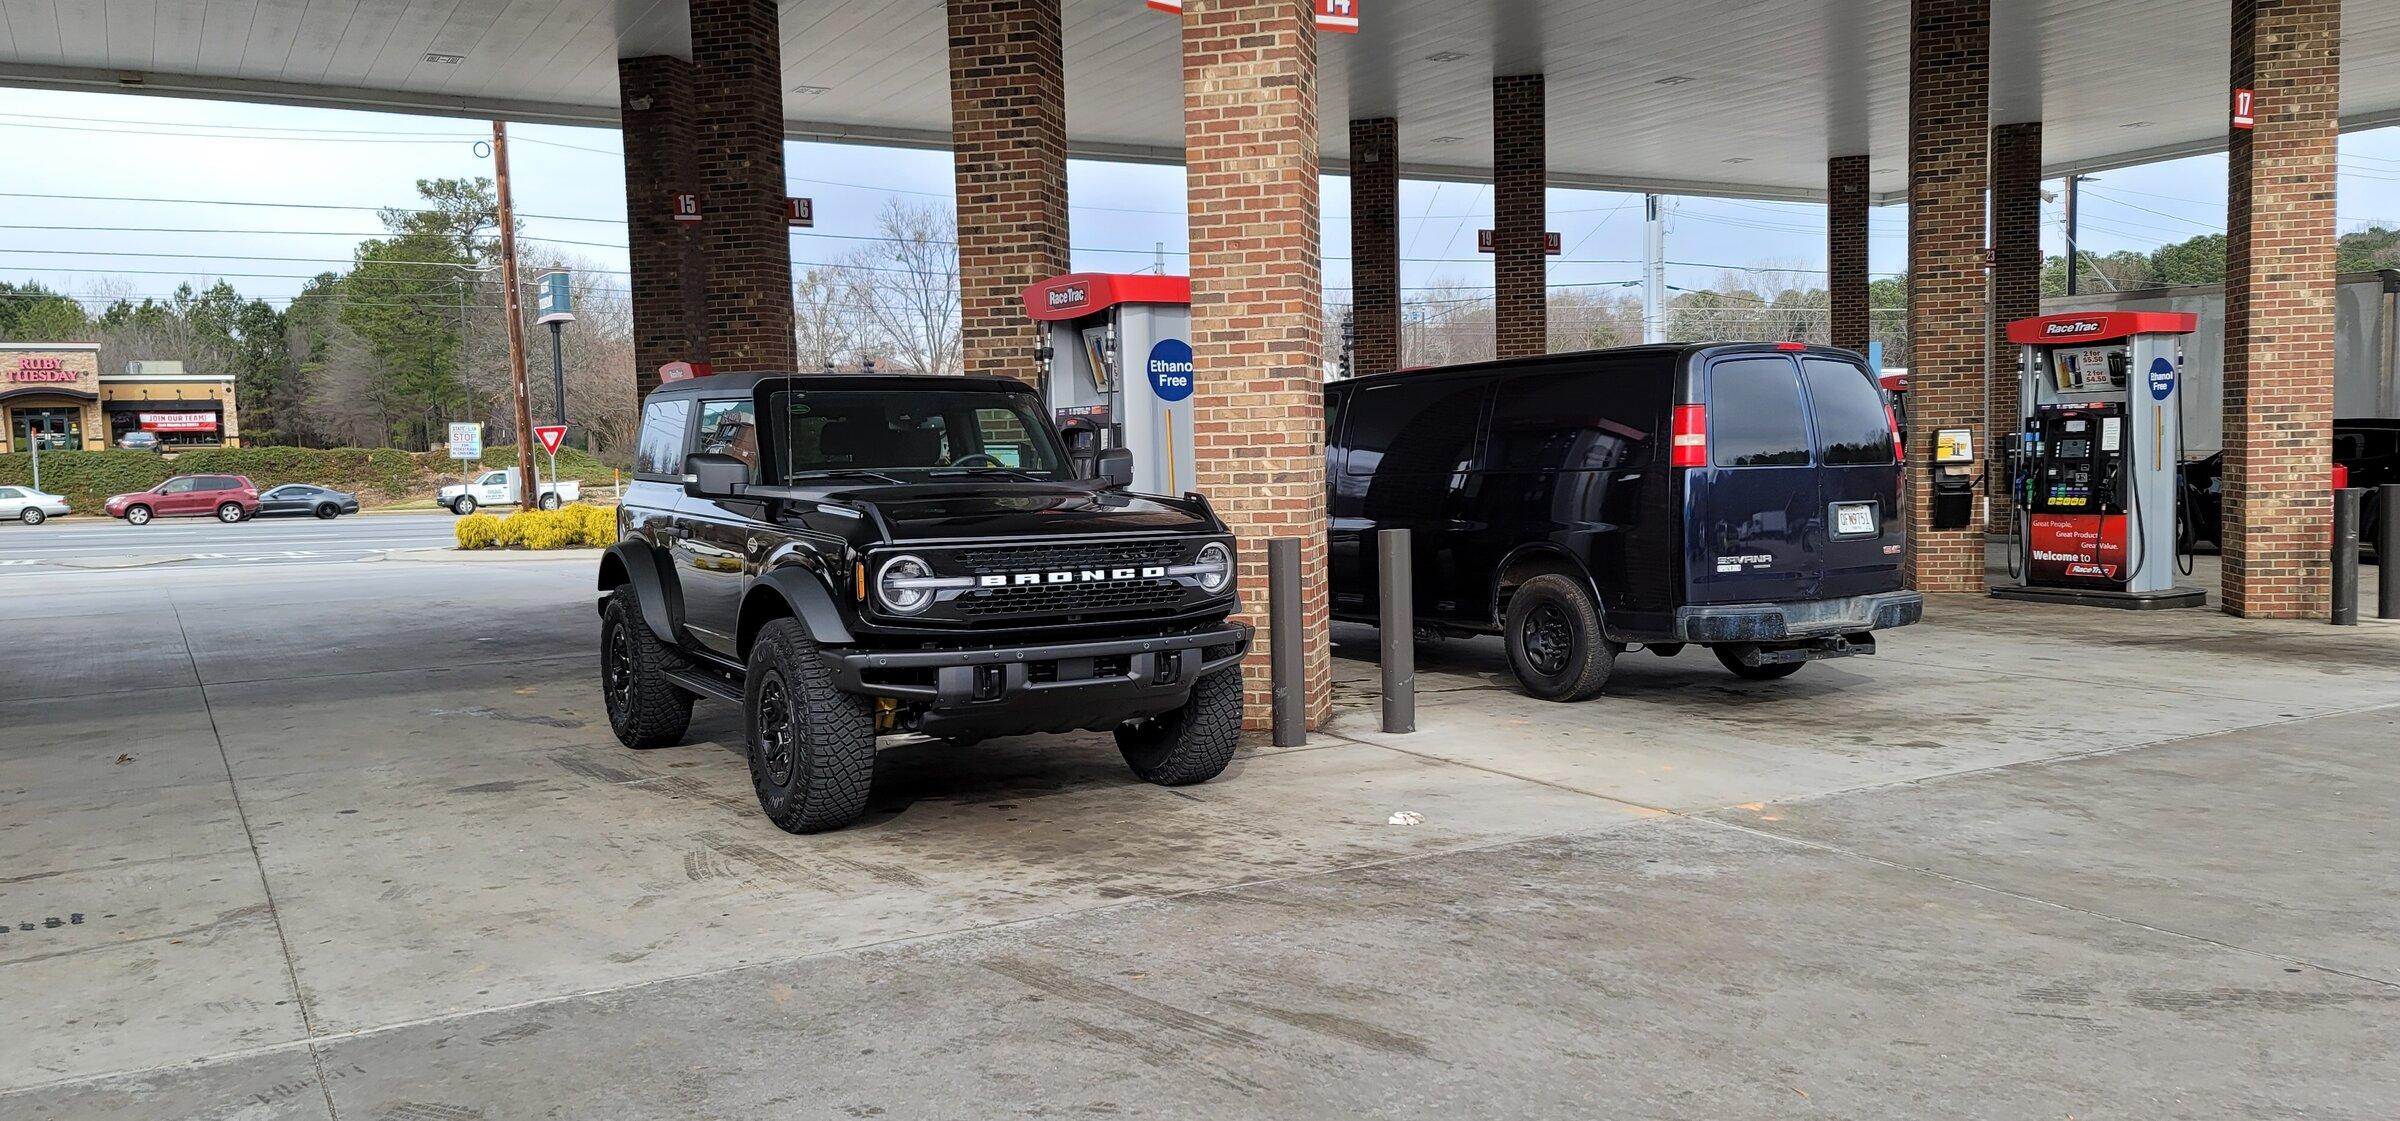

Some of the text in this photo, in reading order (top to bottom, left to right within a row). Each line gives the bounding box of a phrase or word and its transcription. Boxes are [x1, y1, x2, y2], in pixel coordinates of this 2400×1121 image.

[2239, 92, 2251, 115] 17
[678, 194, 696, 214] 15
[793, 199, 809, 218] 16
[1481, 231, 1492, 246] 19
[1548, 234, 1558, 247] 20
[1986, 250, 1996, 261] 23
[1049, 288, 1085, 306] RaceTrac
[2047, 321, 2098, 334] RaceTrac
[20, 358, 63, 370] RUBY
[1150, 360, 1193, 372] Ethano
[7, 370, 78, 382] TUESDAY
[1159, 374, 1187, 387] Free
[2150, 371, 2174, 381] Ethanol
[2153, 382, 2168, 390] Free
[453, 433, 477, 441] STOP
[2050, 521, 2073, 529] People.
[2074, 531, 2103, 539] Product.
[1717, 554, 1772, 564] SAVANA
[2033, 550, 2091, 562] Welcome to
[981, 566, 1166, 587] BRONCO
